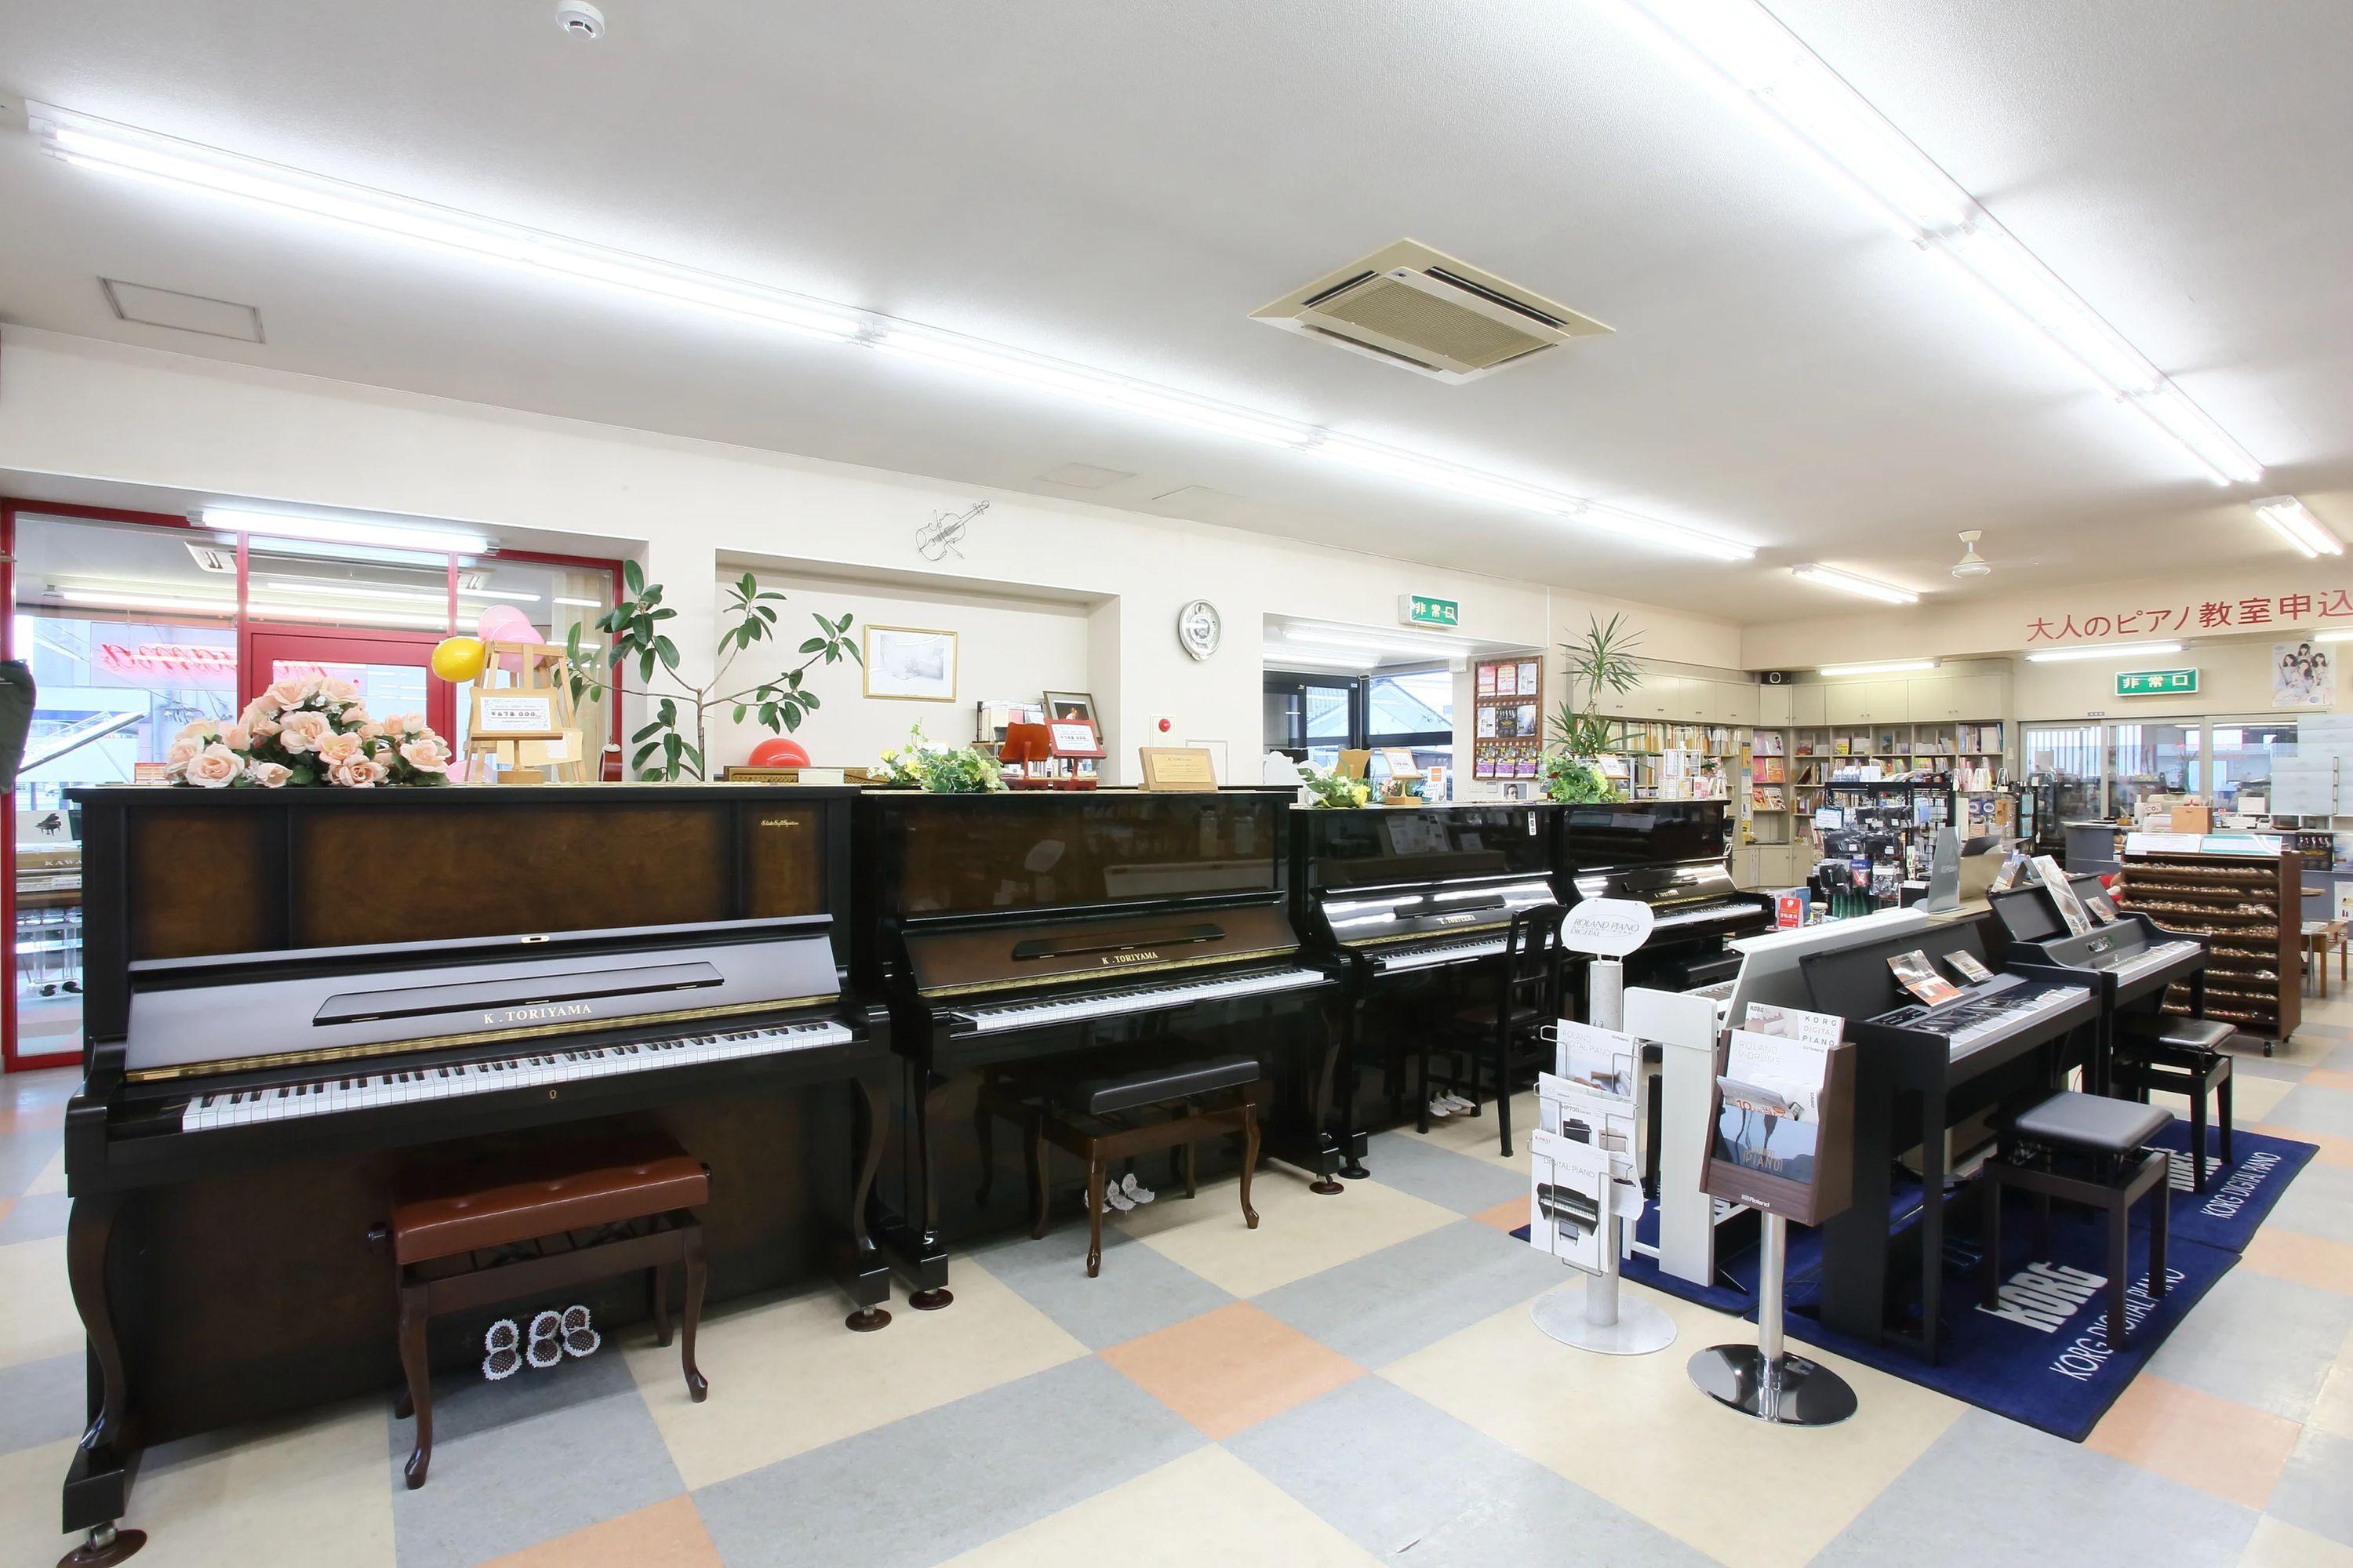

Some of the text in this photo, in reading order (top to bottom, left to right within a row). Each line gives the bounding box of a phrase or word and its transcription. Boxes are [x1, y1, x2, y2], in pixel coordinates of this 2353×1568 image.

[1415, 601, 1455, 618] 非常口
[2027, 589, 2353, 642] 大人のピアノ教室申込
[2122, 675, 2189, 689] 非常口
[1570, 928, 1600, 937] DIGITAL
[1573, 918, 1609, 929] ROLAND
[1610, 922, 1640, 933] PIANO
[1805, 1015, 1837, 1027] KORG
[1562, 1030, 1591, 1042] ROLAND
[1803, 1025, 1836, 1037] DIGITAL
[1802, 1035, 1835, 1046] PIANO
[1739, 1041, 1779, 1055] ROLAND
[1561, 1104, 1580, 1113] HP700
[1544, 1157, 1595, 1178] DIGITAL PIANO
[2200, 1151, 2282, 1219] KORG DIGITAL PIANO
[1748, 1196, 1770, 1208] Roland
[2049, 1337, 2114, 1381] KORG
